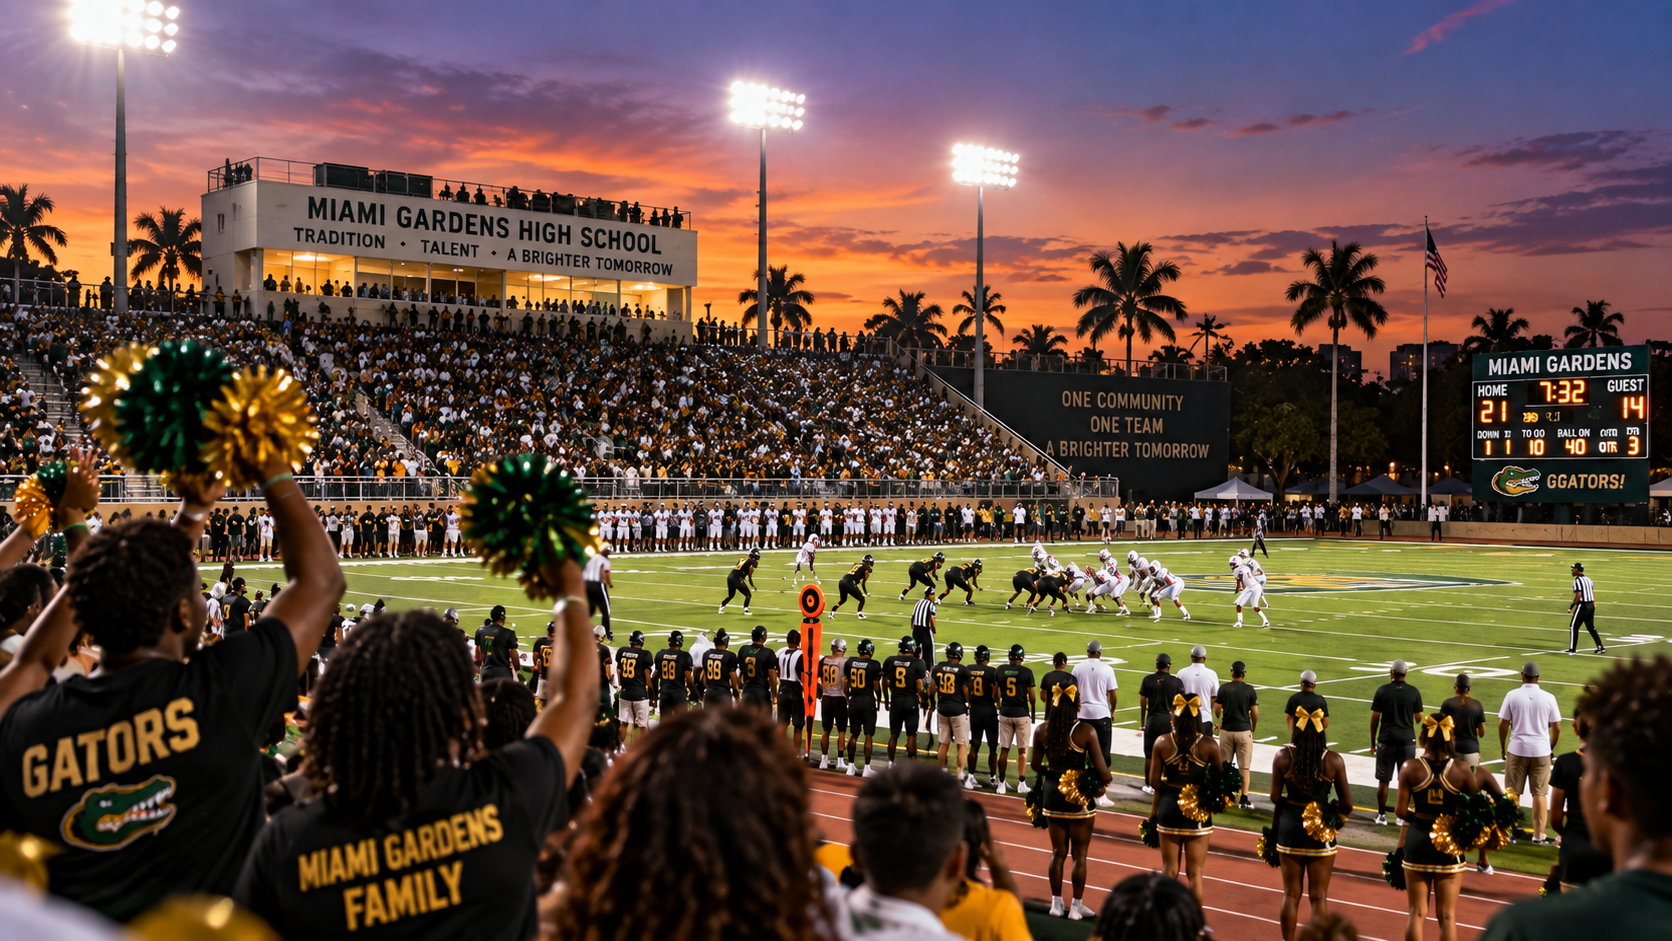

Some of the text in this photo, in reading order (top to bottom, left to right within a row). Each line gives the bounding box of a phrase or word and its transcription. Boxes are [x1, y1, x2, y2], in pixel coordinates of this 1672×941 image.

[307, 195, 662, 255] MIAMI GARDENS HIGH SCHOOL
[293, 227, 674, 277] TRADITION TALENT A BRIGHTER TOMORROW
[1488, 352, 1632, 376] MIAMI GARDENS
[1477, 384, 1508, 397] HOME
[1539, 379, 1586, 404] 7:32
[1607, 378, 1644, 392] GUEST
[1061, 390, 1184, 411] ONE COMMUNITY
[1622, 396, 1644, 420] 14
[1480, 400, 1507, 423] 21
[1090, 415, 1164, 434] ONE TEAM
[1521, 429, 1533, 438] TO
[1045, 440, 1210, 459] A BRIGHTER TOMORROW
[1529, 439, 1545, 456] 10
[1565, 439, 1587, 455] 40
[1627, 436, 1639, 455] 3
[1546, 473, 1626, 489] GGATORS!
[22, 696, 201, 799] GATORS
[298, 803, 506, 894] MIAMI GARDENS
[343, 861, 464, 932] FAMILY
